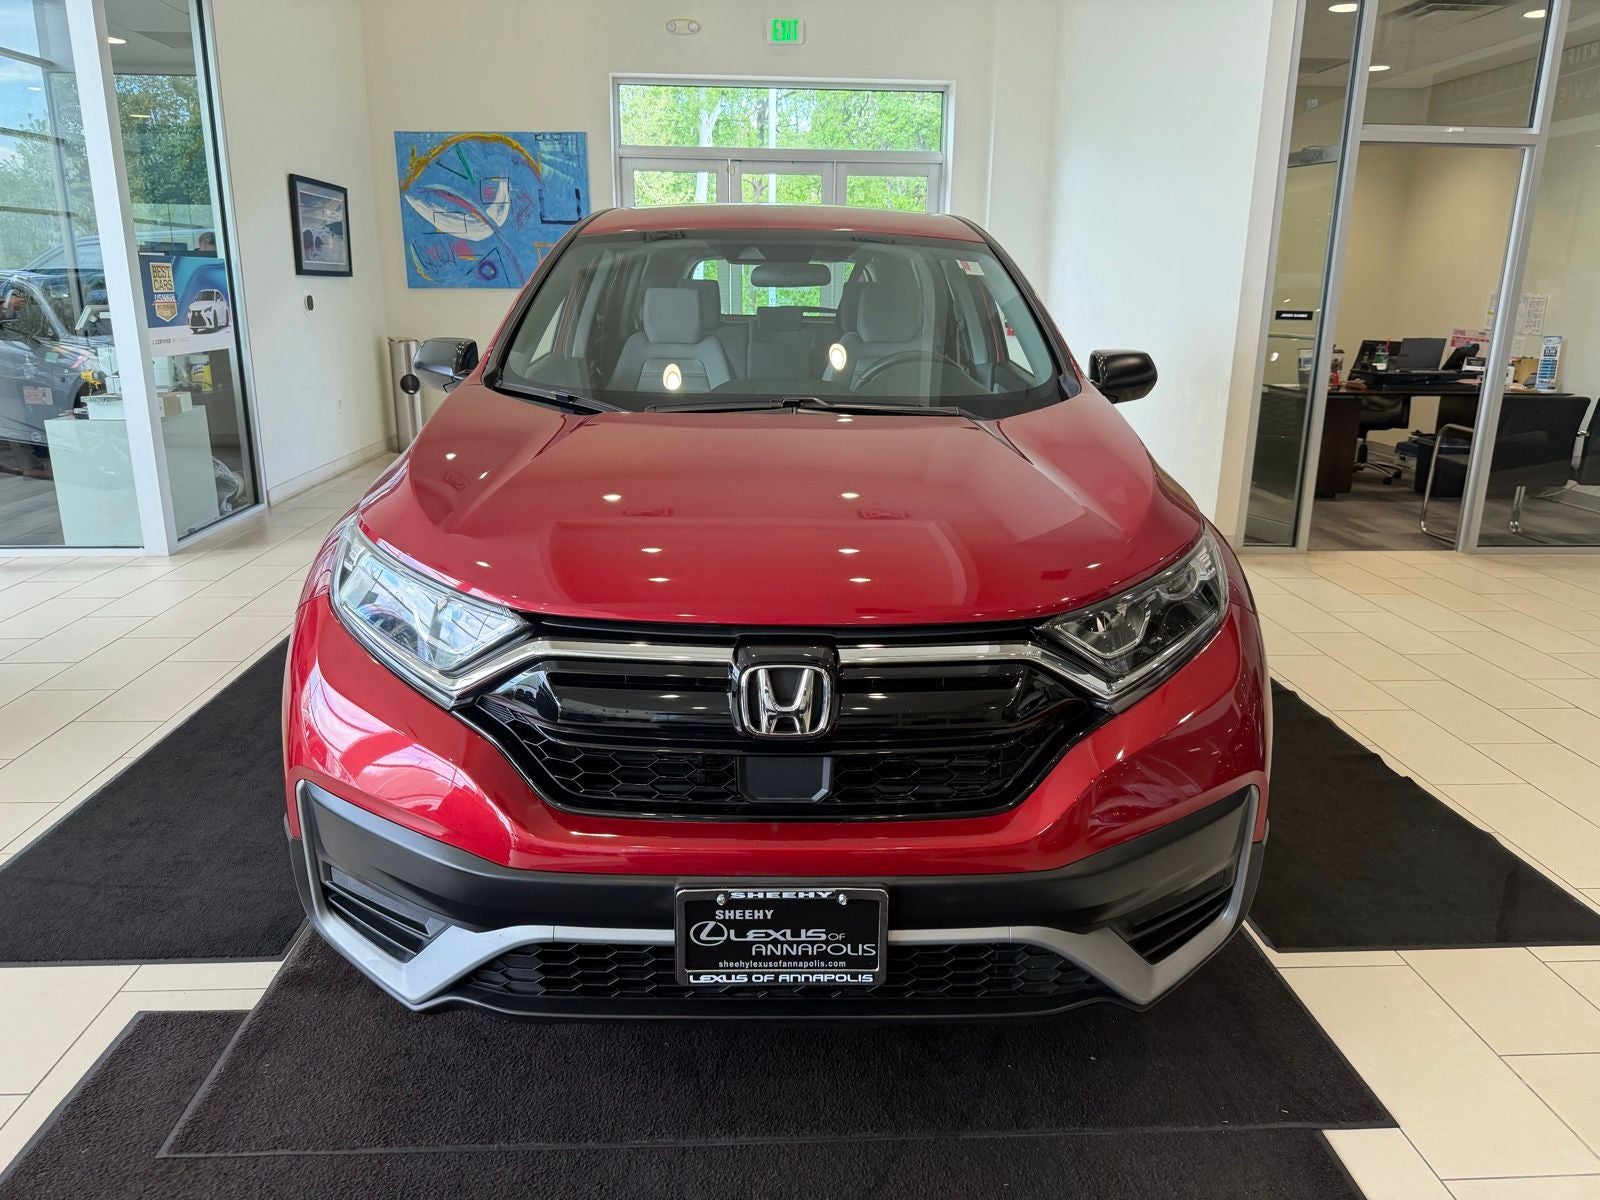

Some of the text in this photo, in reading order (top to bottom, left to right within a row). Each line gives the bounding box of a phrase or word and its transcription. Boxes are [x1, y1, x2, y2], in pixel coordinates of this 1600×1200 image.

[772, 18, 800, 41] EXIT
[152, 265, 170, 278] BEST
[153, 279, 173, 291] CARS
[715, 909, 774, 920] SHEEHY
[729, 928, 827, 941] LEXUS
[827, 933, 846, 941] OF
[751, 943, 876, 956] ANNAPOLIS
[718, 960, 846, 969] sheehylexusofannapolis.com
[689, 974, 874, 983] LEXUS OF ANNAPOLIS
